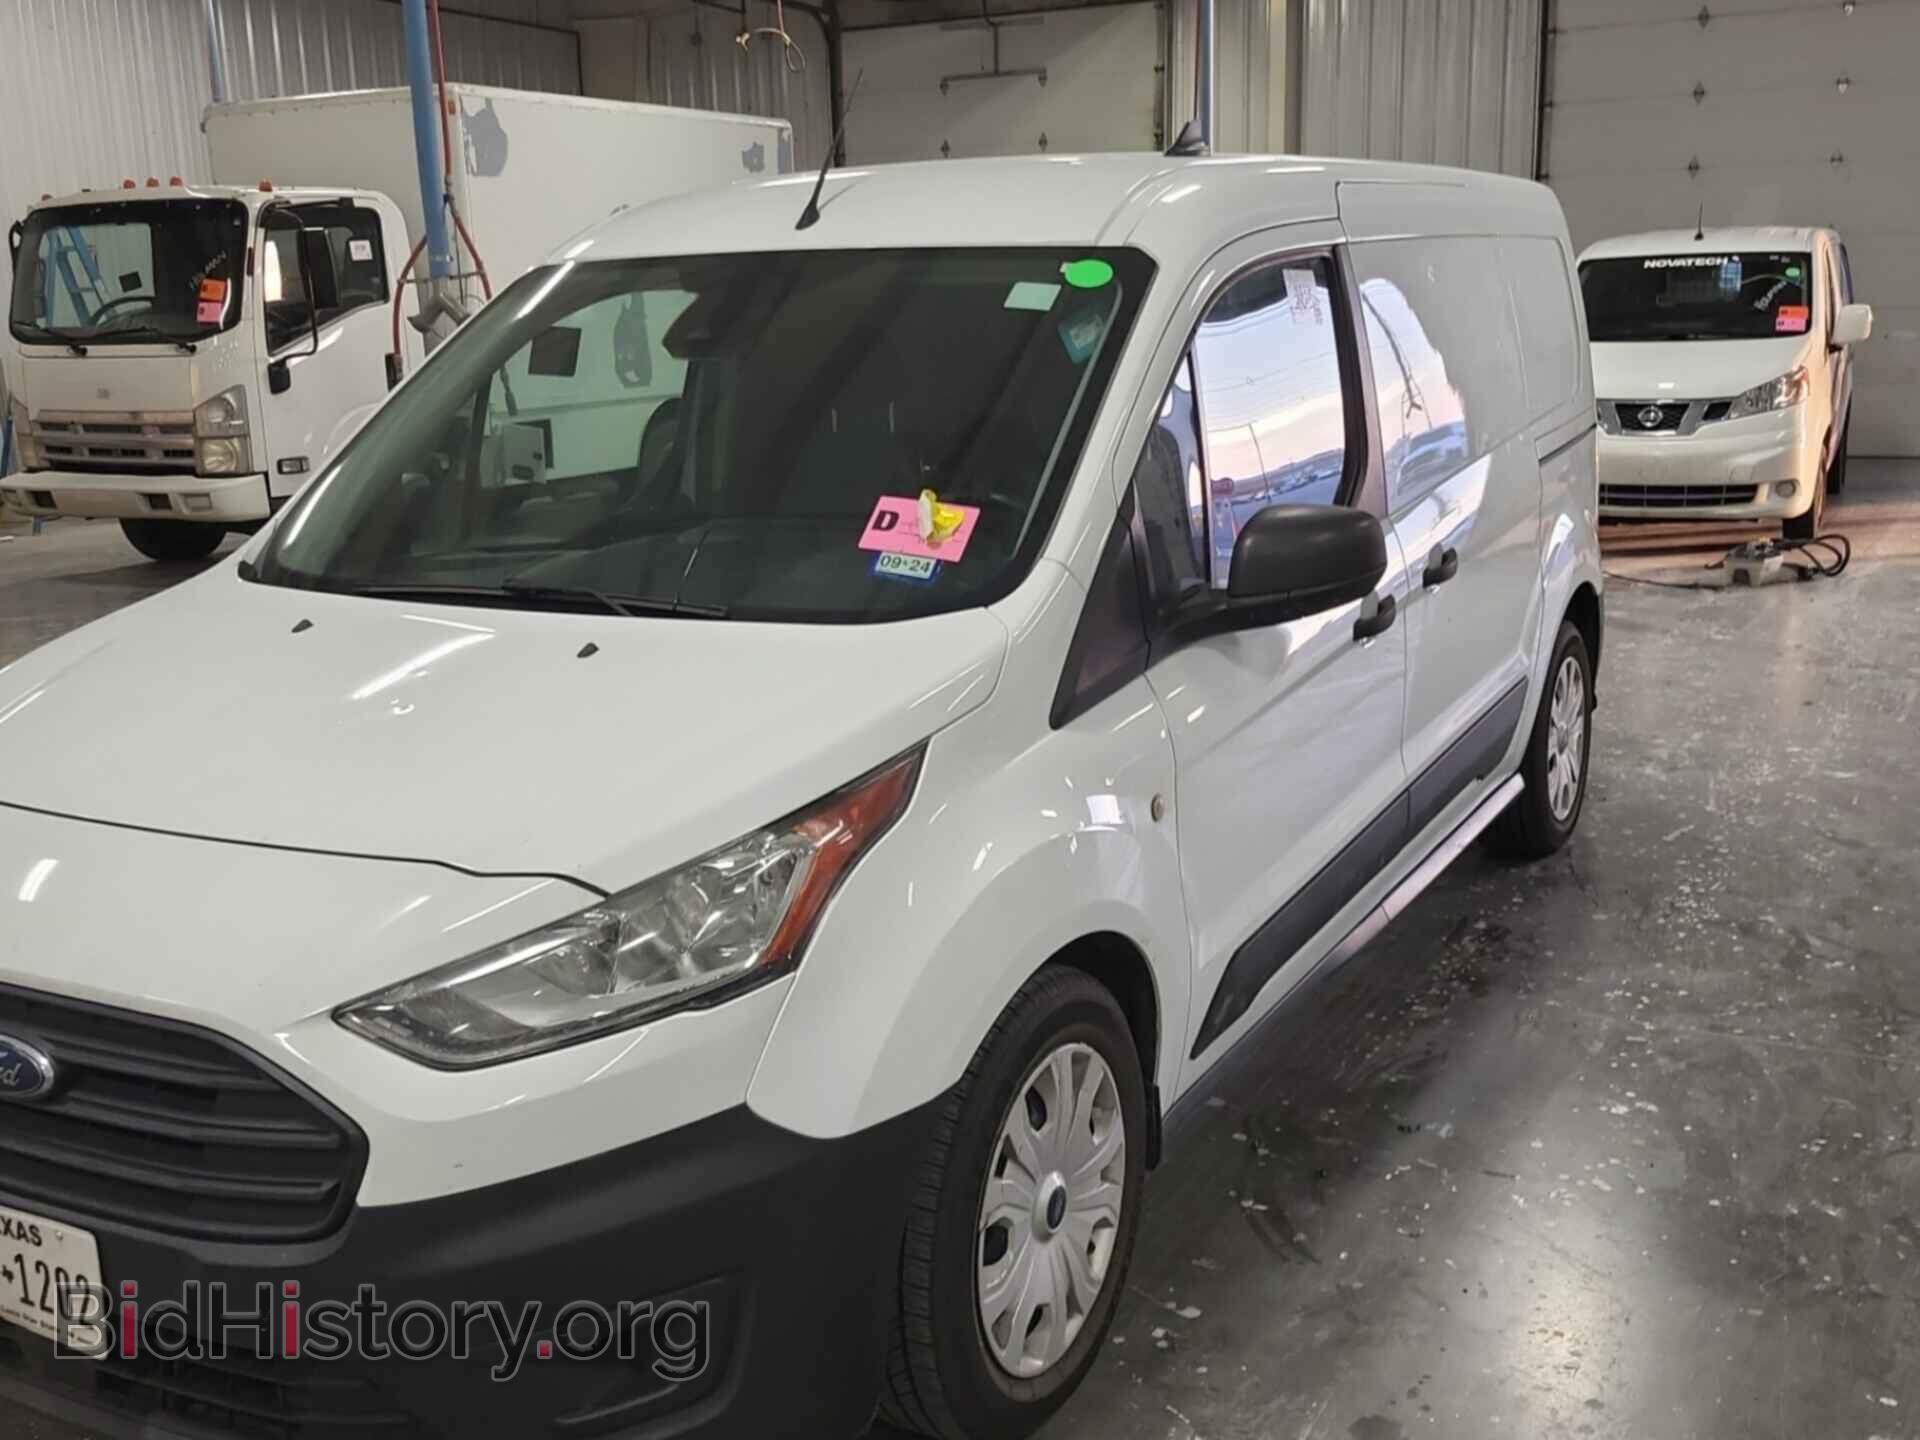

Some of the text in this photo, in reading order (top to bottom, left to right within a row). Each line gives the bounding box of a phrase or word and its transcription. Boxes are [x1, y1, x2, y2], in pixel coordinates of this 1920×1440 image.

[1643, 256, 1729, 269] NOVATECH
[872, 510, 900, 532] D
[0, 1216, 42, 1247] XAS
